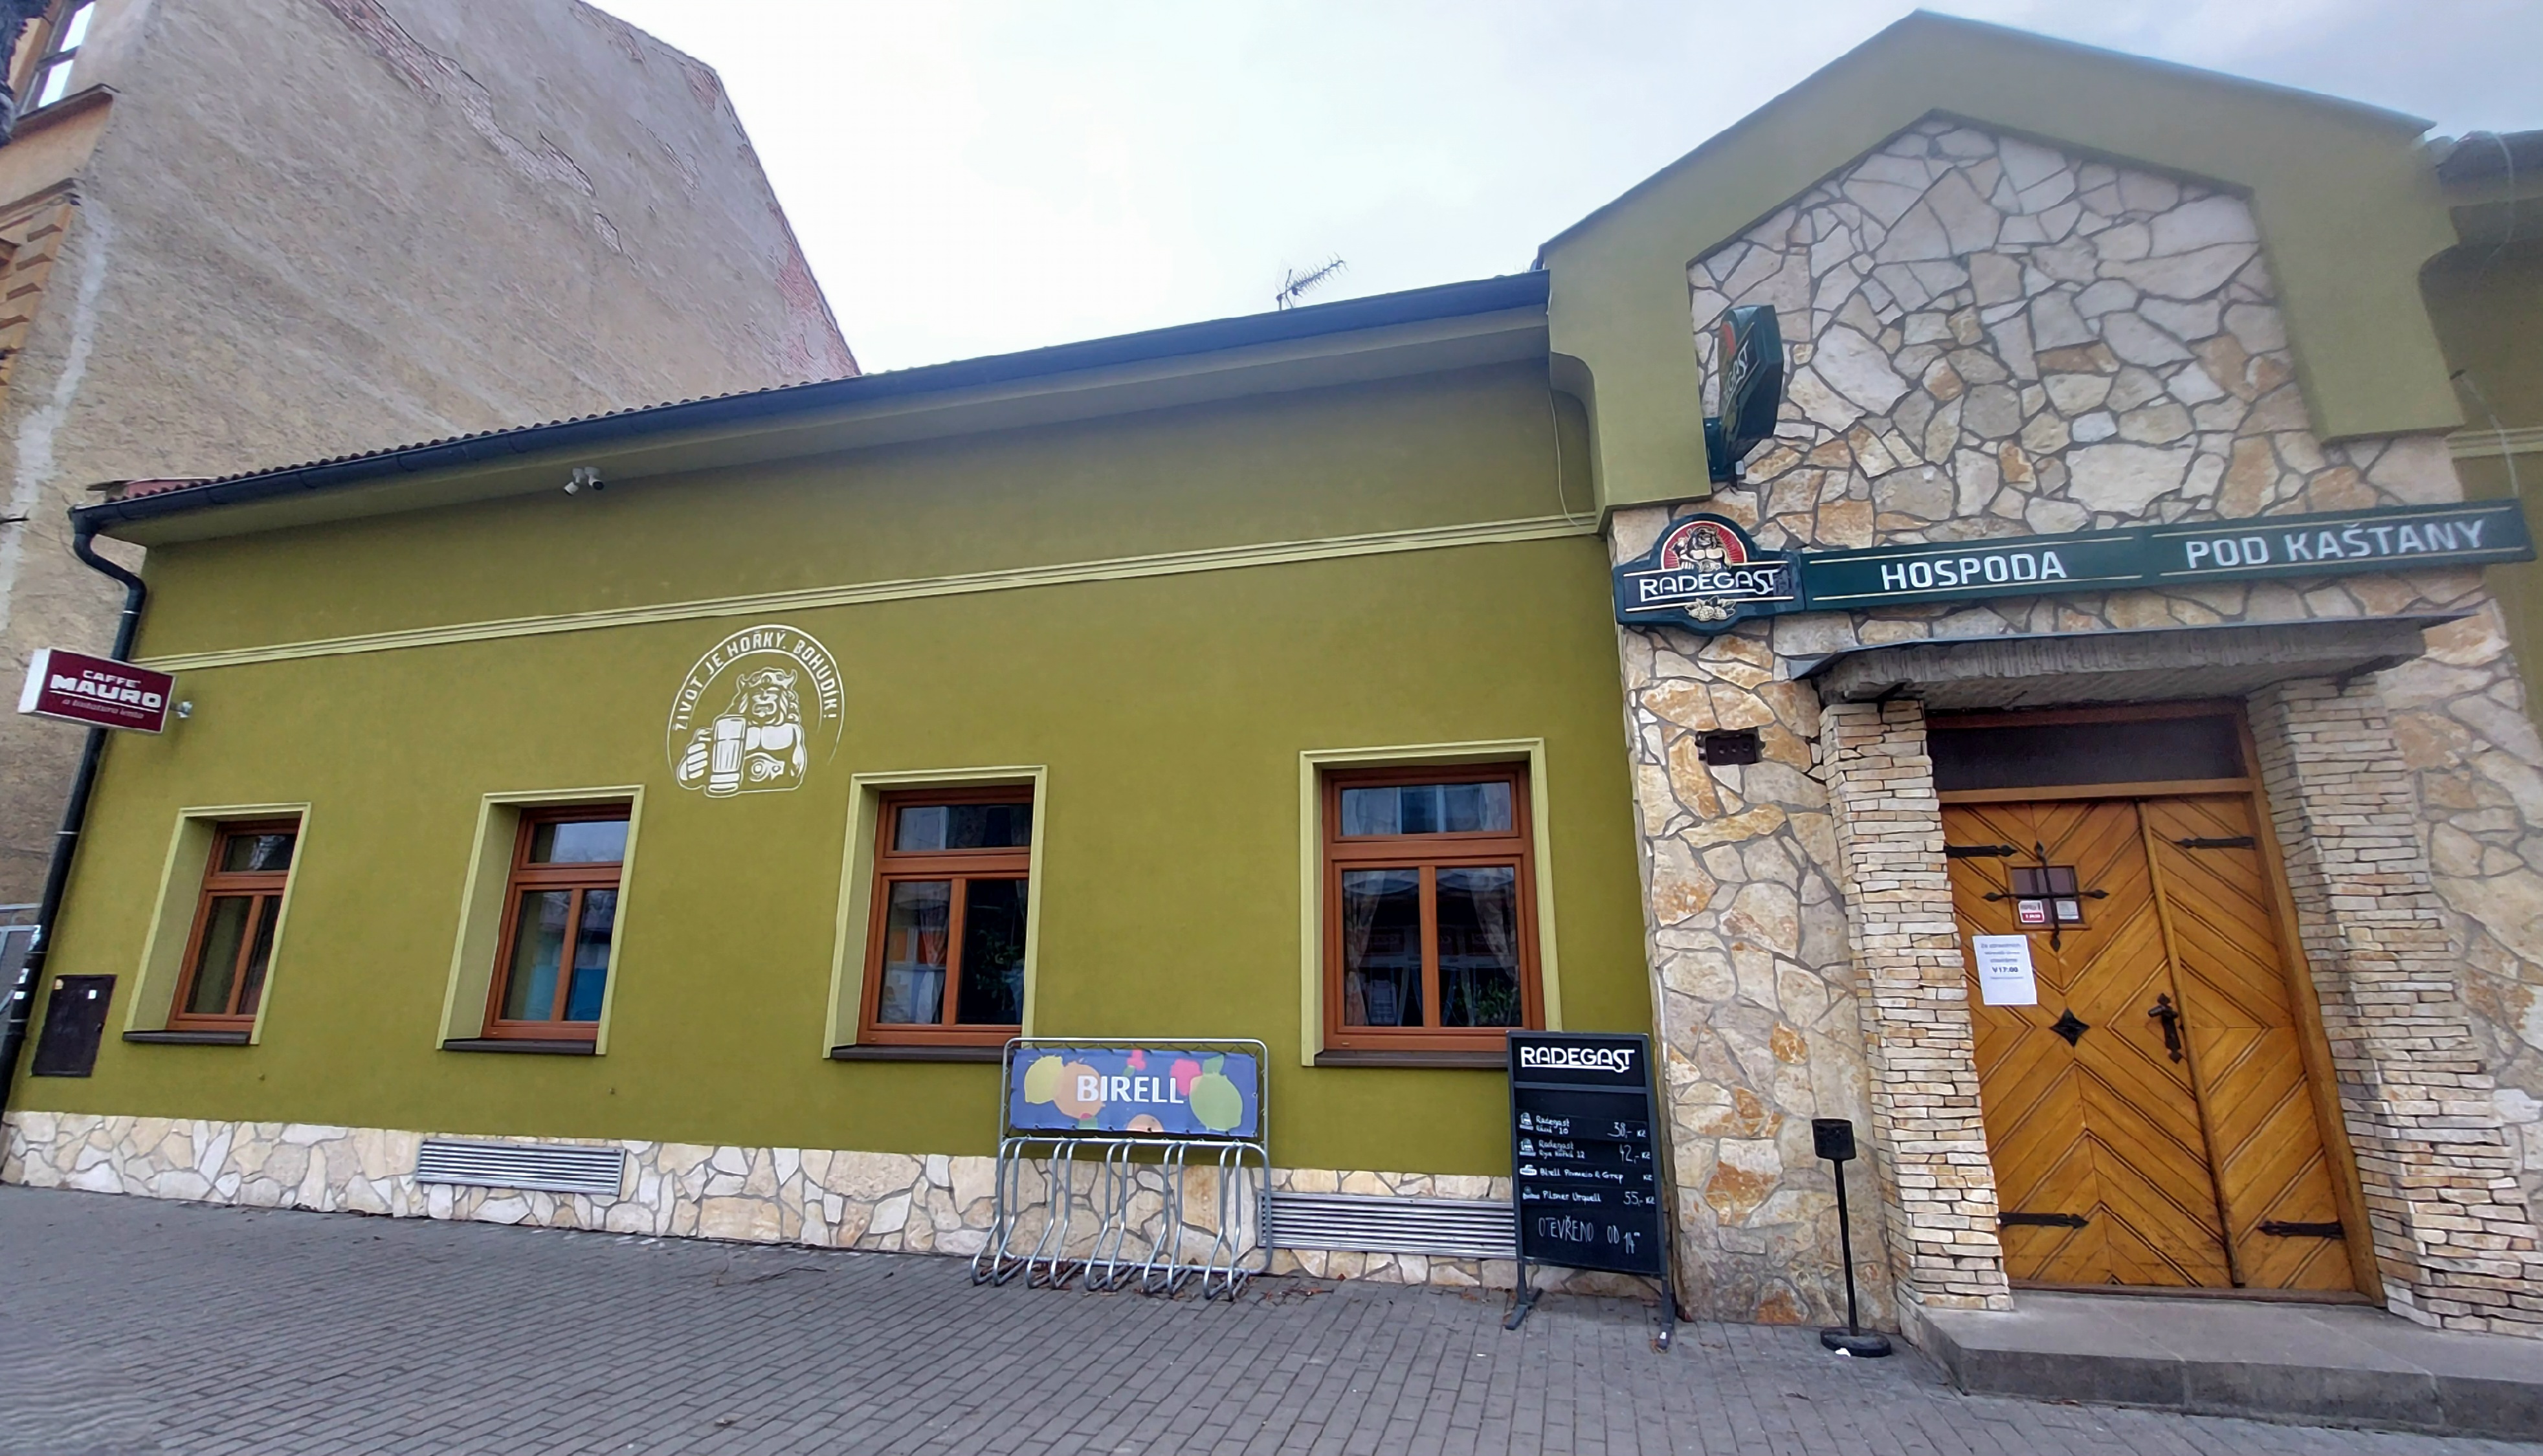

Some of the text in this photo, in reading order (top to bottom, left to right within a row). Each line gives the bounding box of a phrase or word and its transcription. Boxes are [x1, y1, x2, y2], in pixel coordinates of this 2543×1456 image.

[1881, 518, 2485, 590] HOSPODA POD KAŠTANY
[1639, 569, 1779, 602] RADEGAST
[50, 674, 161, 708] MAURO
[672, 676, 703, 731] ŽIVOT
[705, 652, 724, 675] JE
[1520, 1046, 1636, 1073] RADEGAST
[1077, 1075, 1184, 1104] BIRELL
[1536, 1115, 1570, 1129] Radegast
[1538, 1139, 1574, 1151] Radegast
[1538, 1215, 1594, 1242] OTEVŘENO
[1606, 1225, 1619, 1244] OD
